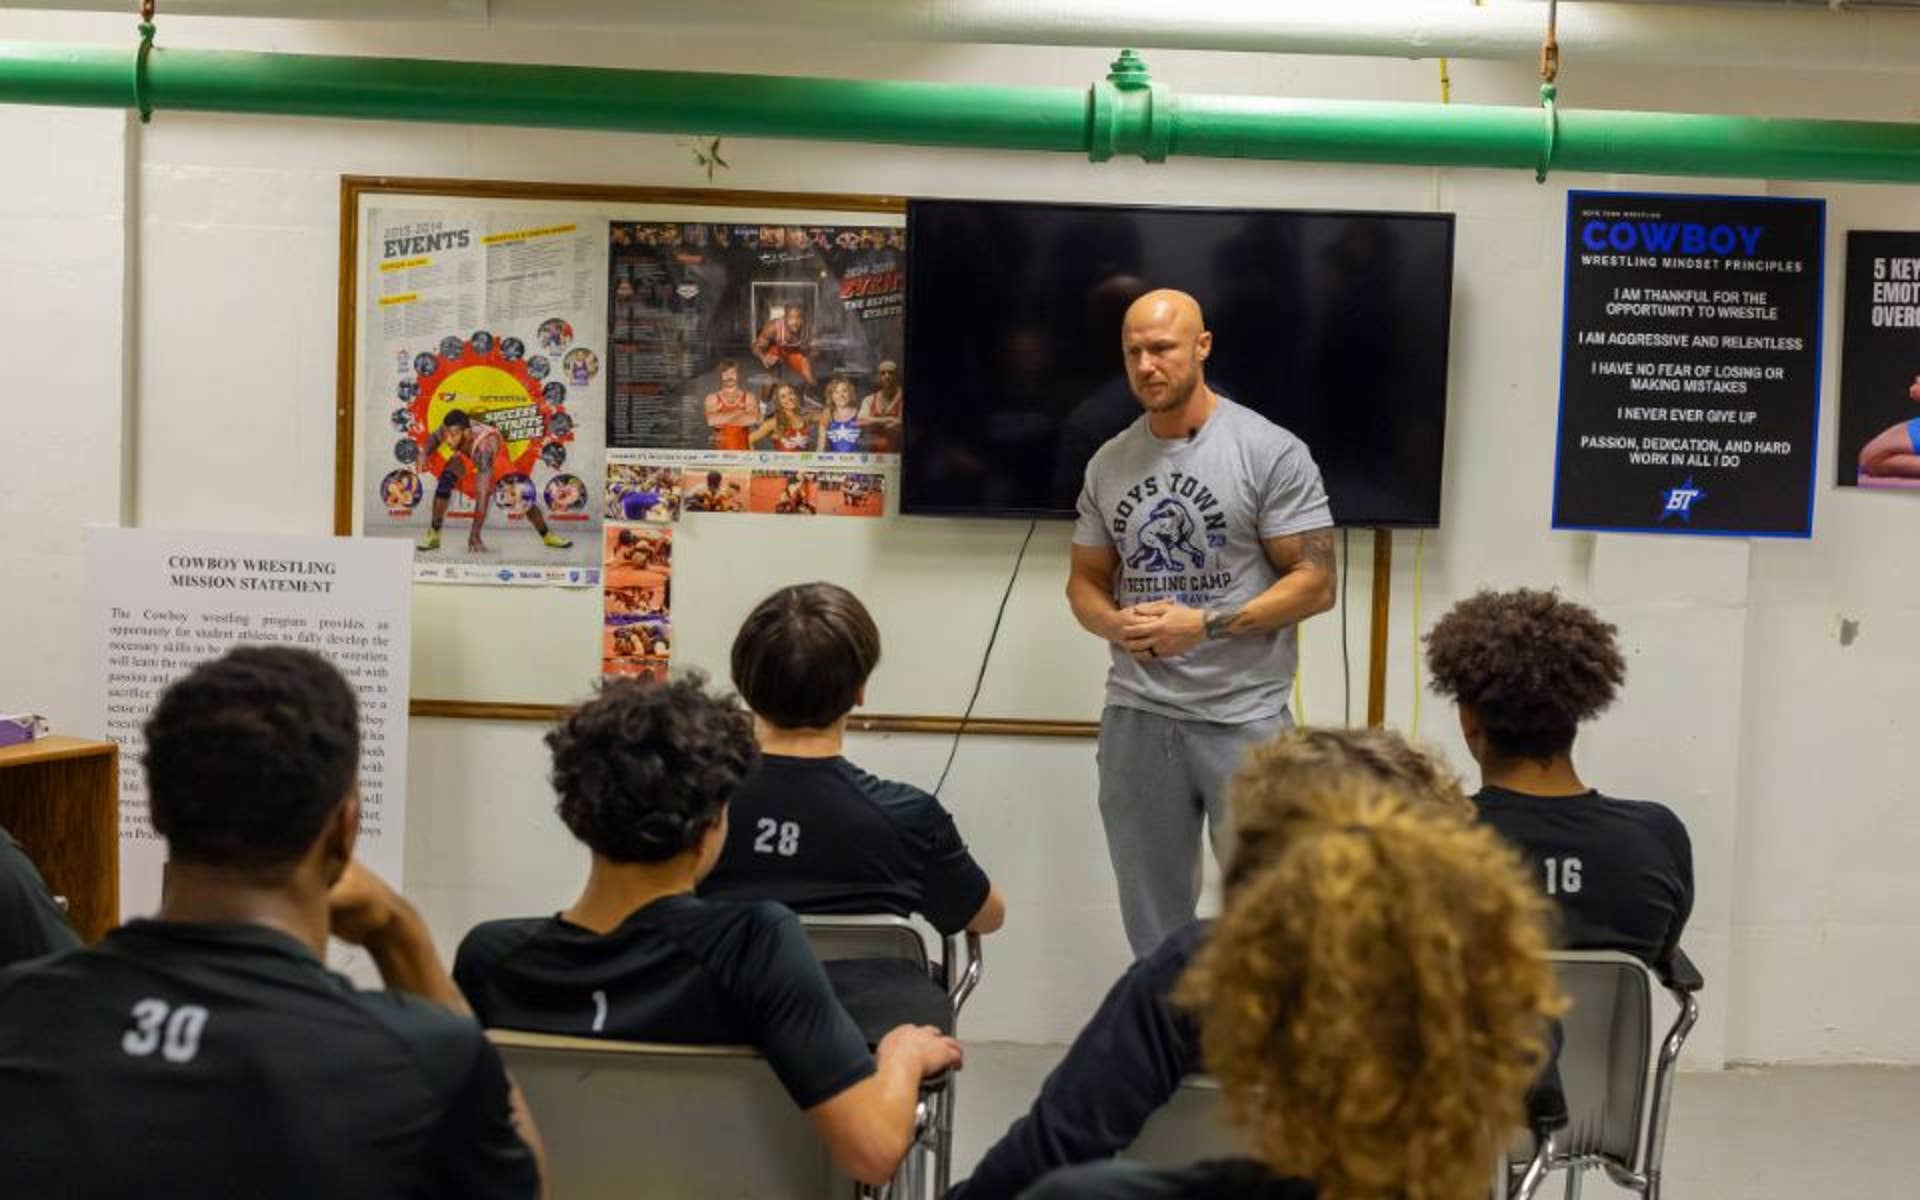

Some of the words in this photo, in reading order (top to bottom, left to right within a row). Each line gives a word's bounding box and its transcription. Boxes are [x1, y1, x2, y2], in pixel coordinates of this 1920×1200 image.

[384, 229, 470, 258] EVENTS
[1583, 219, 1762, 256] COWBOY
[1581, 255, 1657, 268] WRESTLING
[1662, 258, 1720, 270] MINDSET
[1725, 259, 1803, 272] PRINCIPLES
[1873, 257, 1886, 279] 5
[1614, 287, 1619, 300] I
[1621, 287, 1641, 301] AM
[1644, 289, 1710, 303] THANKFUL
[1714, 291, 1739, 304] FOR
[1743, 292, 1767, 305] THE
[1606, 303, 1695, 317] OPPORTUNITY
[1698, 305, 1715, 318] TO
[1718, 306, 1778, 320] WRESTLE
[1578, 332, 1583, 344] I
[1585, 332, 1605, 345] AM
[1607, 332, 1689, 347] AGGRESSIVE
[1691, 335, 1718, 348] AND
[1722, 336, 1803, 351] RELENTLESS
[1591, 361, 1597, 374] I
[1599, 362, 1633, 375] HAVE
[1636, 363, 1655, 376] NO
[1658, 364, 1691, 377] FEAR
[1694, 365, 1712, 378] OF
[1715, 366, 1762, 379] LOSING
[1765, 367, 1784, 380] OR
[1630, 378, 1681, 392] MAKING
[1683, 380, 1748, 394] MISTAKES
[1617, 407, 1622, 420] I
[1625, 407, 1667, 421] NEVER
[1670, 408, 1704, 422] EVER
[1707, 410, 1735, 423] GIVE
[1739, 411, 1757, 424] UP
[1580, 435, 1640, 450] PASSION,
[1642, 437, 1722, 453] DEDICATION,
[1725, 440, 1752, 453] AND
[1755, 441, 1791, 455] HARD
[1629, 452, 1668, 465] WORK
[1671, 453, 1684, 465] IN
[1686, 454, 1711, 467] ALL
[1713, 455, 1718, 467] I
[1721, 455, 1740, 468] DO
[1114, 476, 1159, 533] BOYS
[1170, 473, 1227, 531] TOWN
[1665, 489, 1699, 511] BT
[168, 555, 237, 571] COWBOY
[243, 559, 336, 575] WRESTLING
[170, 575, 236, 589] MISSION
[240, 577, 333, 593] STATEMENT
[1190, 572, 1232, 592] CAMP
[111, 607, 131, 619] The
[143, 608, 188, 623] Cowboy
[202, 612, 249, 627] wrestling
[262, 616, 307, 629] program
[319, 616, 365, 630] provides
[109, 625, 170, 640] opportunity
[326, 633, 369, 647] develop
[372, 635, 389, 646] the
[754, 817, 800, 856] 28
[1544, 857, 1583, 896] 16
[592, 990, 608, 1032] 1
[122, 998, 209, 1063] 30
